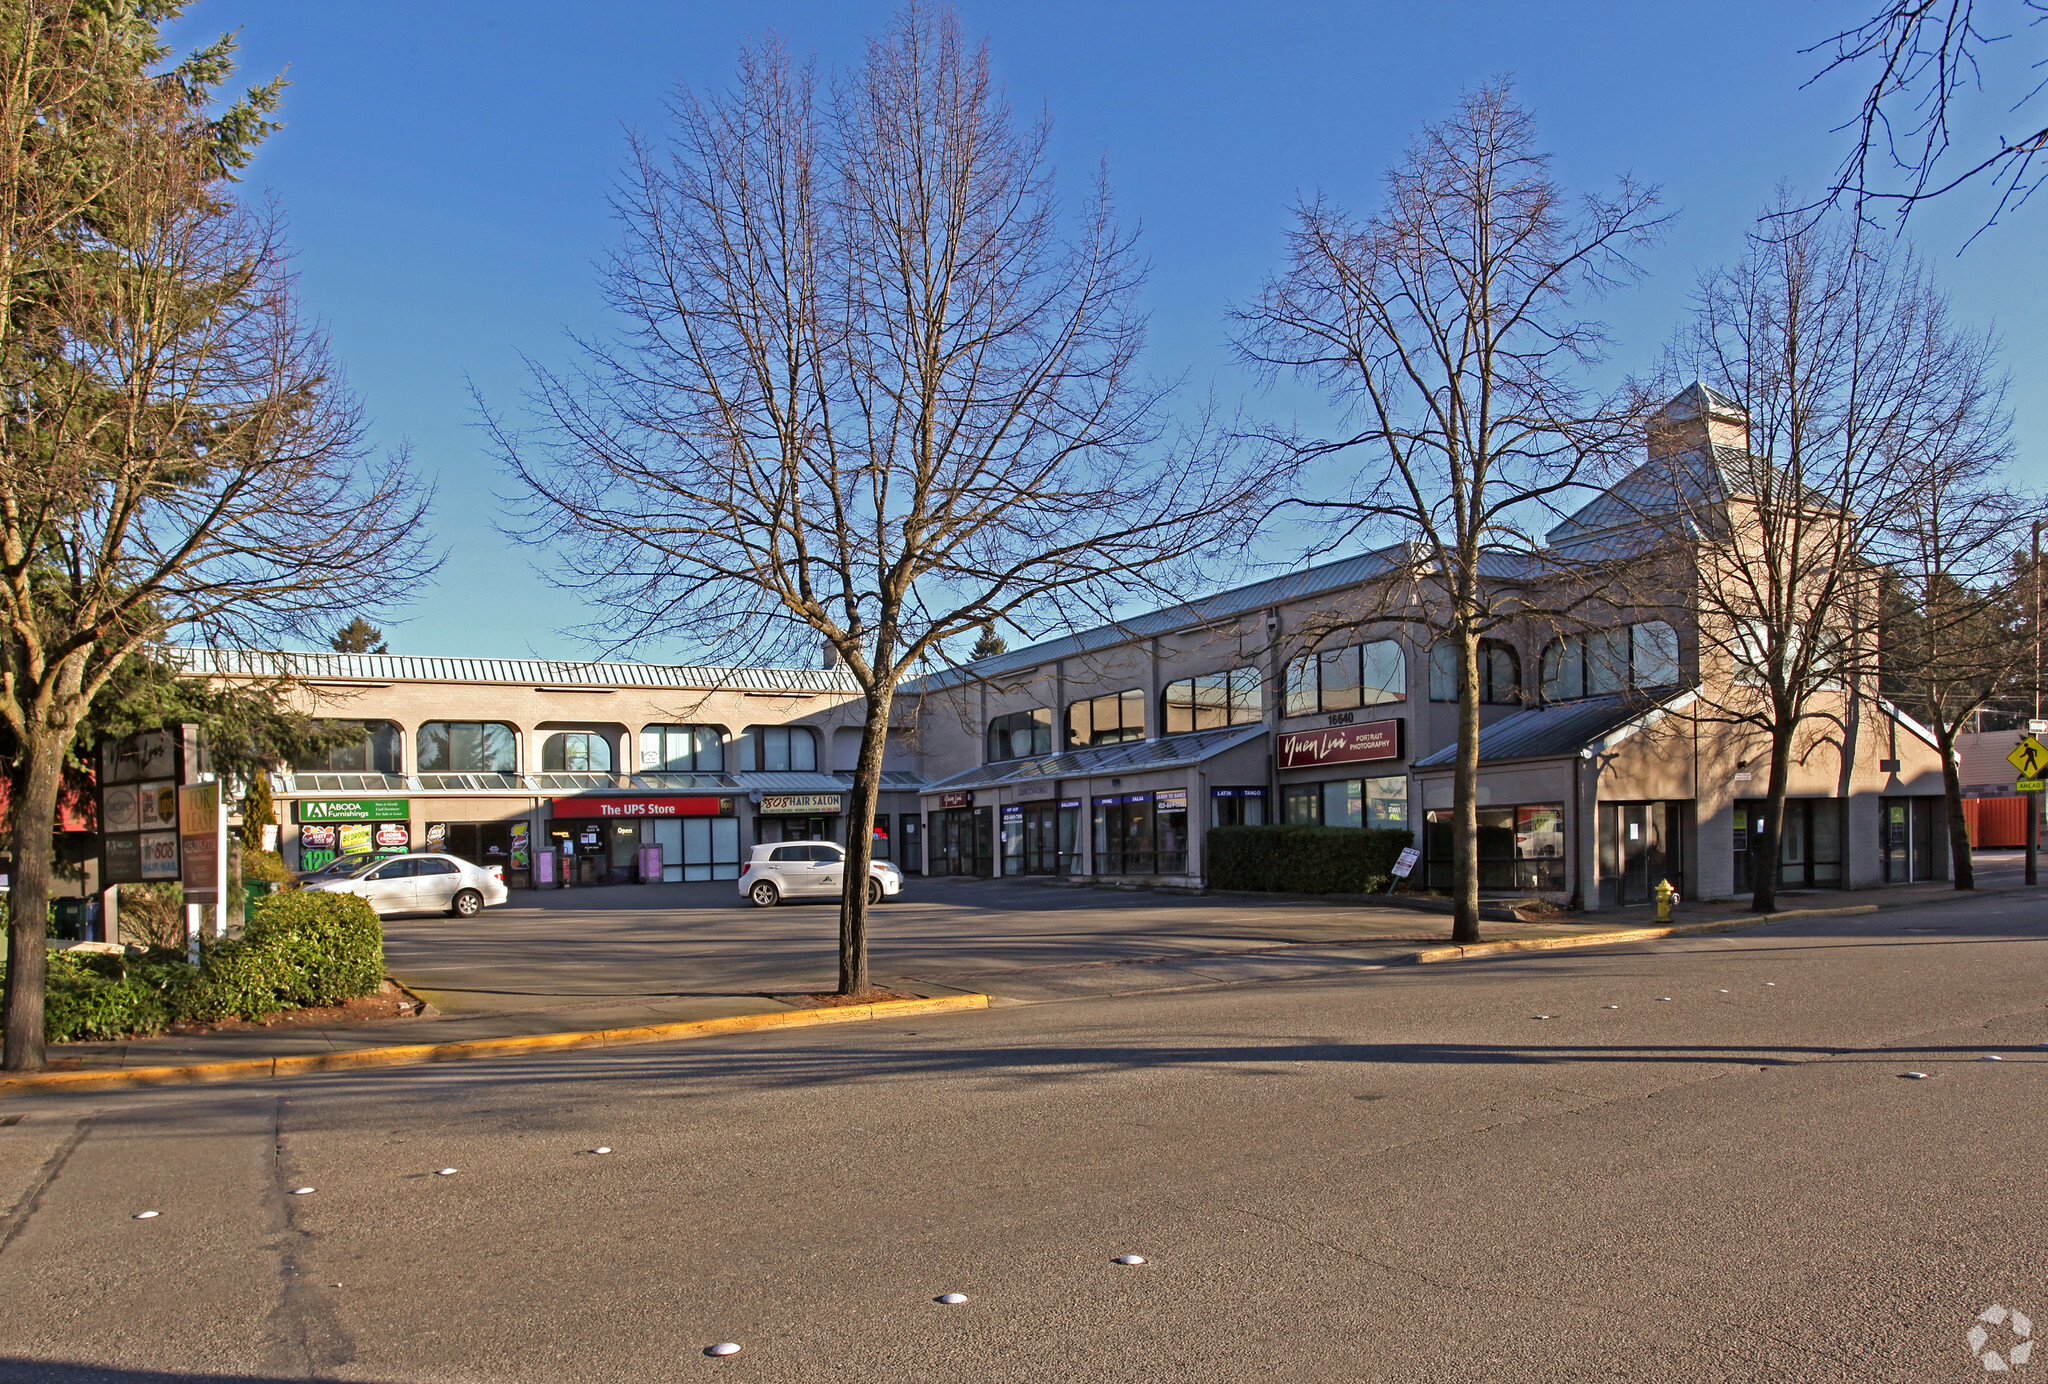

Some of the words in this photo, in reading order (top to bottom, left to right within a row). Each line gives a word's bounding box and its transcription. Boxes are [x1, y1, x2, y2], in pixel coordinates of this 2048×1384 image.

[1328, 712, 1354, 725] 16640
[1355, 732, 1383, 742] PORTRAIT
[1284, 735, 1318, 767] Yuen
[1349, 740, 1390, 750] PHOTOGRAPHY
[189, 789, 211, 810] FOR
[763, 797, 789, 808] 808
[789, 796, 810, 806] HAIR
[812, 795, 839, 805] SALON
[143, 803, 154, 812] UPS
[601, 804, 621, 815] The
[623, 804, 645, 815] UPS
[648, 803, 675, 814] Store
[328, 810, 369, 818] Furnishings
[186, 810, 214, 832] LEASE
[343, 832, 370, 842] BEDROOM
[617, 827, 633, 835] Open
[155, 842, 175, 859] 808
